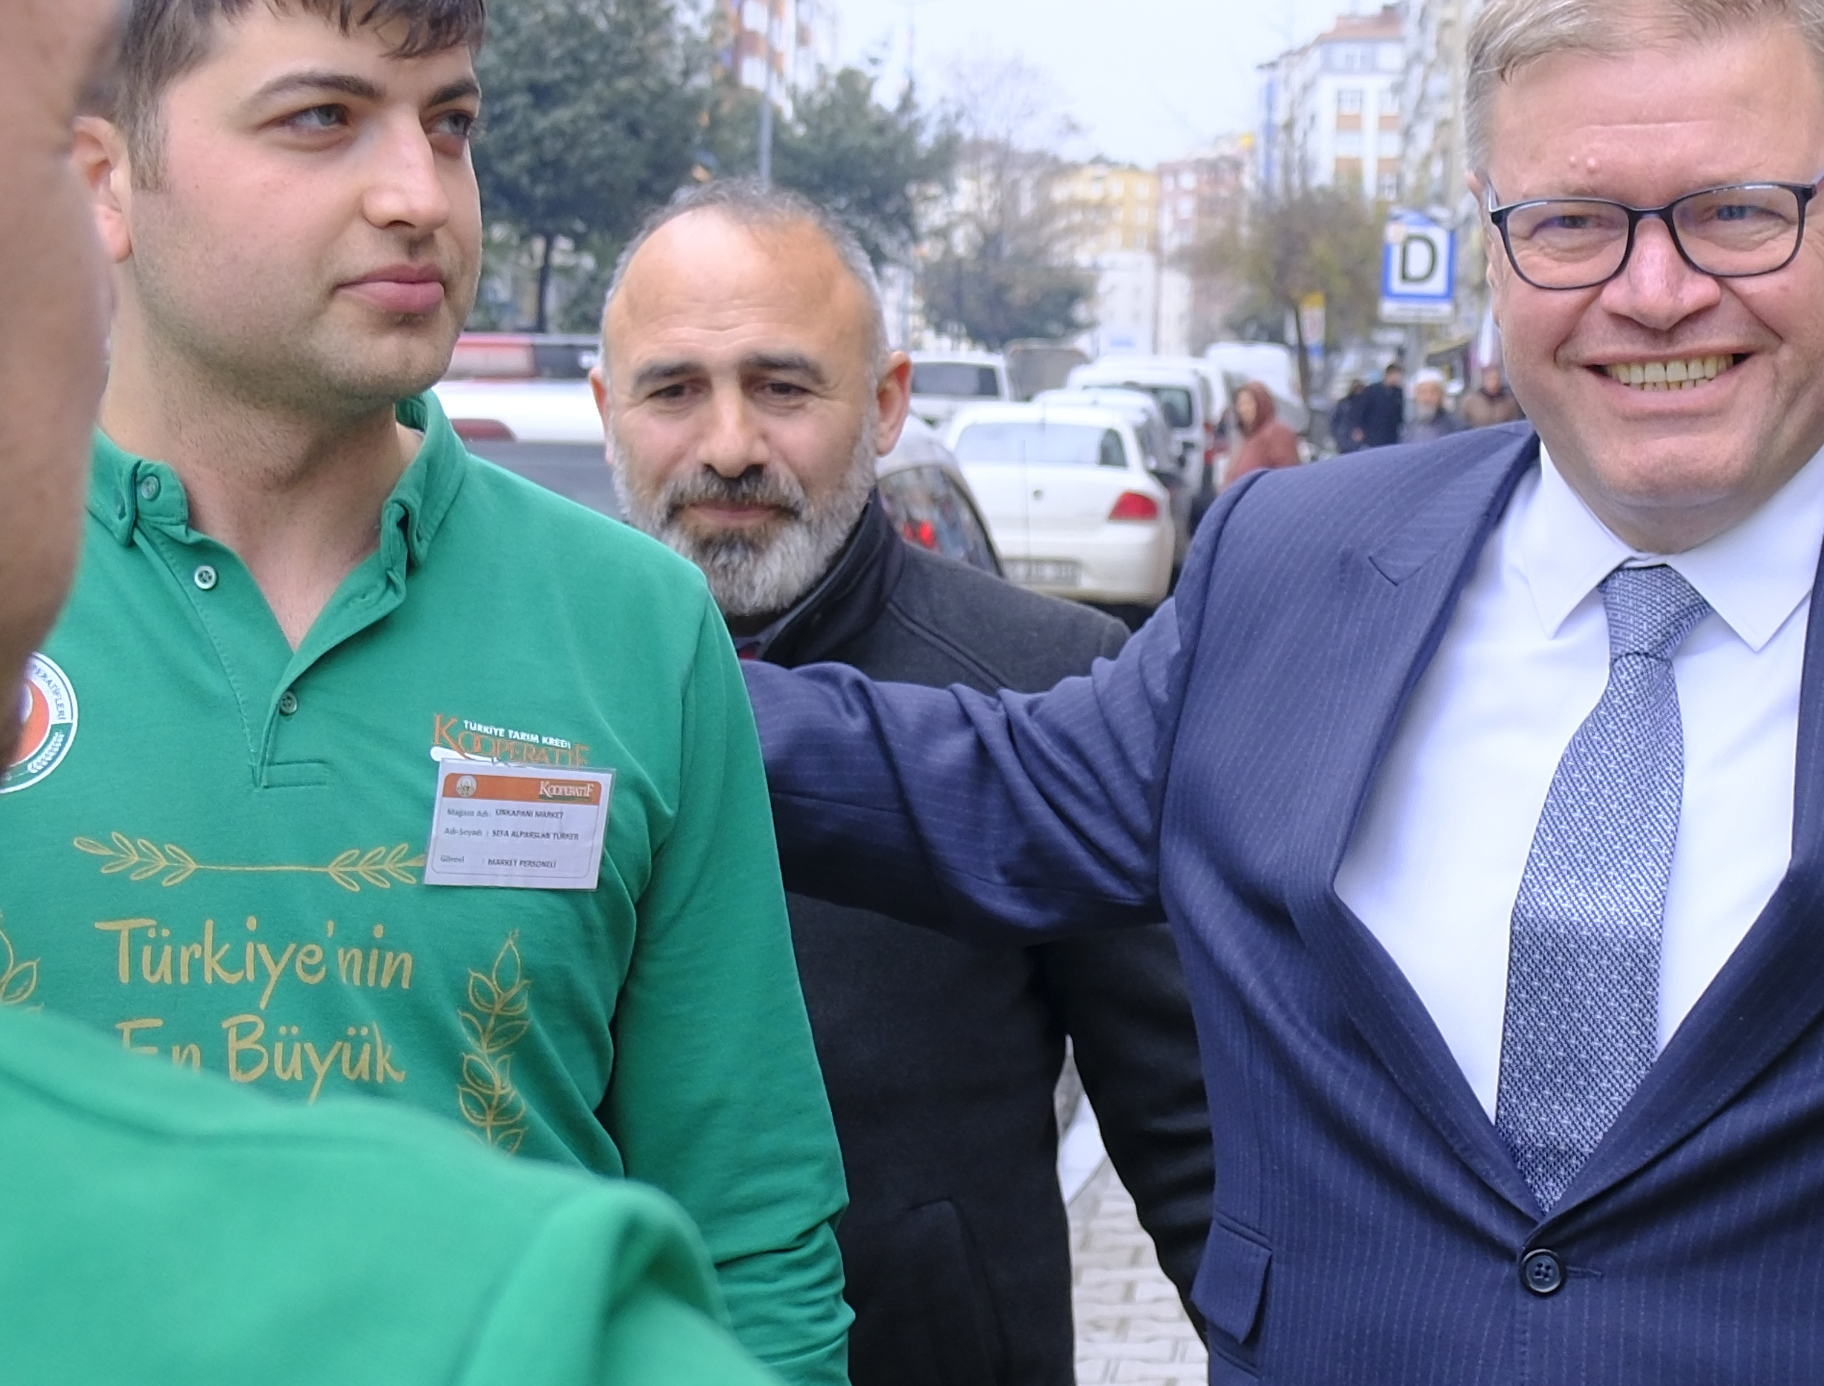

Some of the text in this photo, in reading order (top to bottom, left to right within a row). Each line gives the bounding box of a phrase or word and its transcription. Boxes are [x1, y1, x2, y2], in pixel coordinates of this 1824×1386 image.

[1399, 233, 1438, 284] D
[93, 915, 413, 1011] Türkiye'nin
[221, 1013, 407, 1106] Büyük
